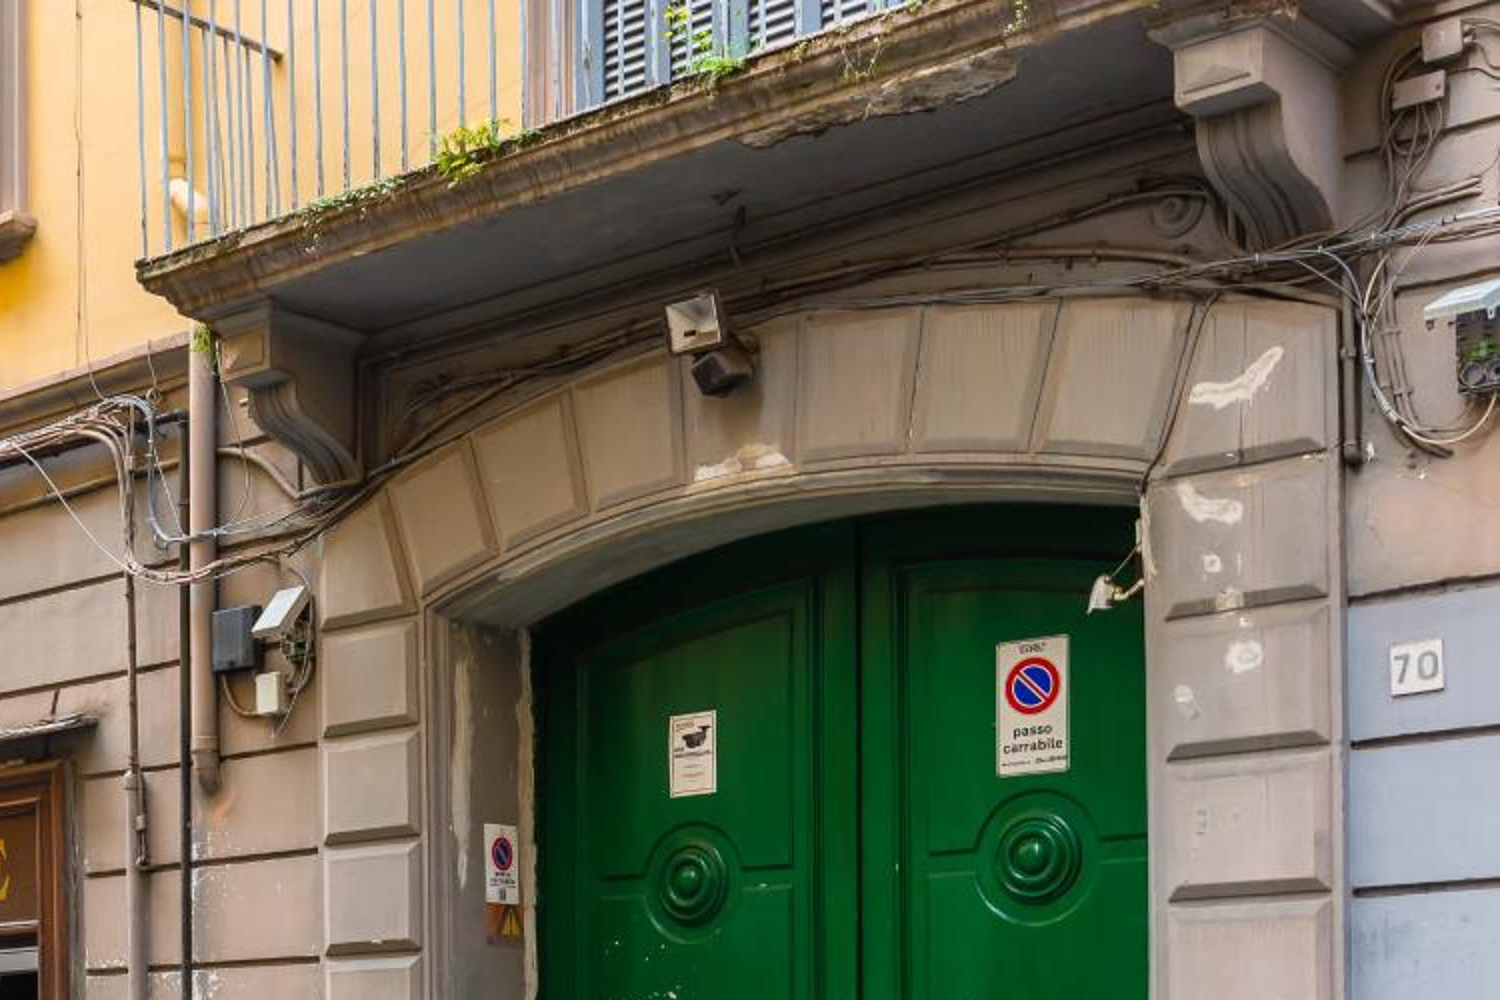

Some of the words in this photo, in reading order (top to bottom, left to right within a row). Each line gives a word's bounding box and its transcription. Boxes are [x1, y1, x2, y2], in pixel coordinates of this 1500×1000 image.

[1393, 650, 1438, 684] 70
[1013, 725, 1053, 740] passo
[1003, 738, 1063, 754] carrabile
